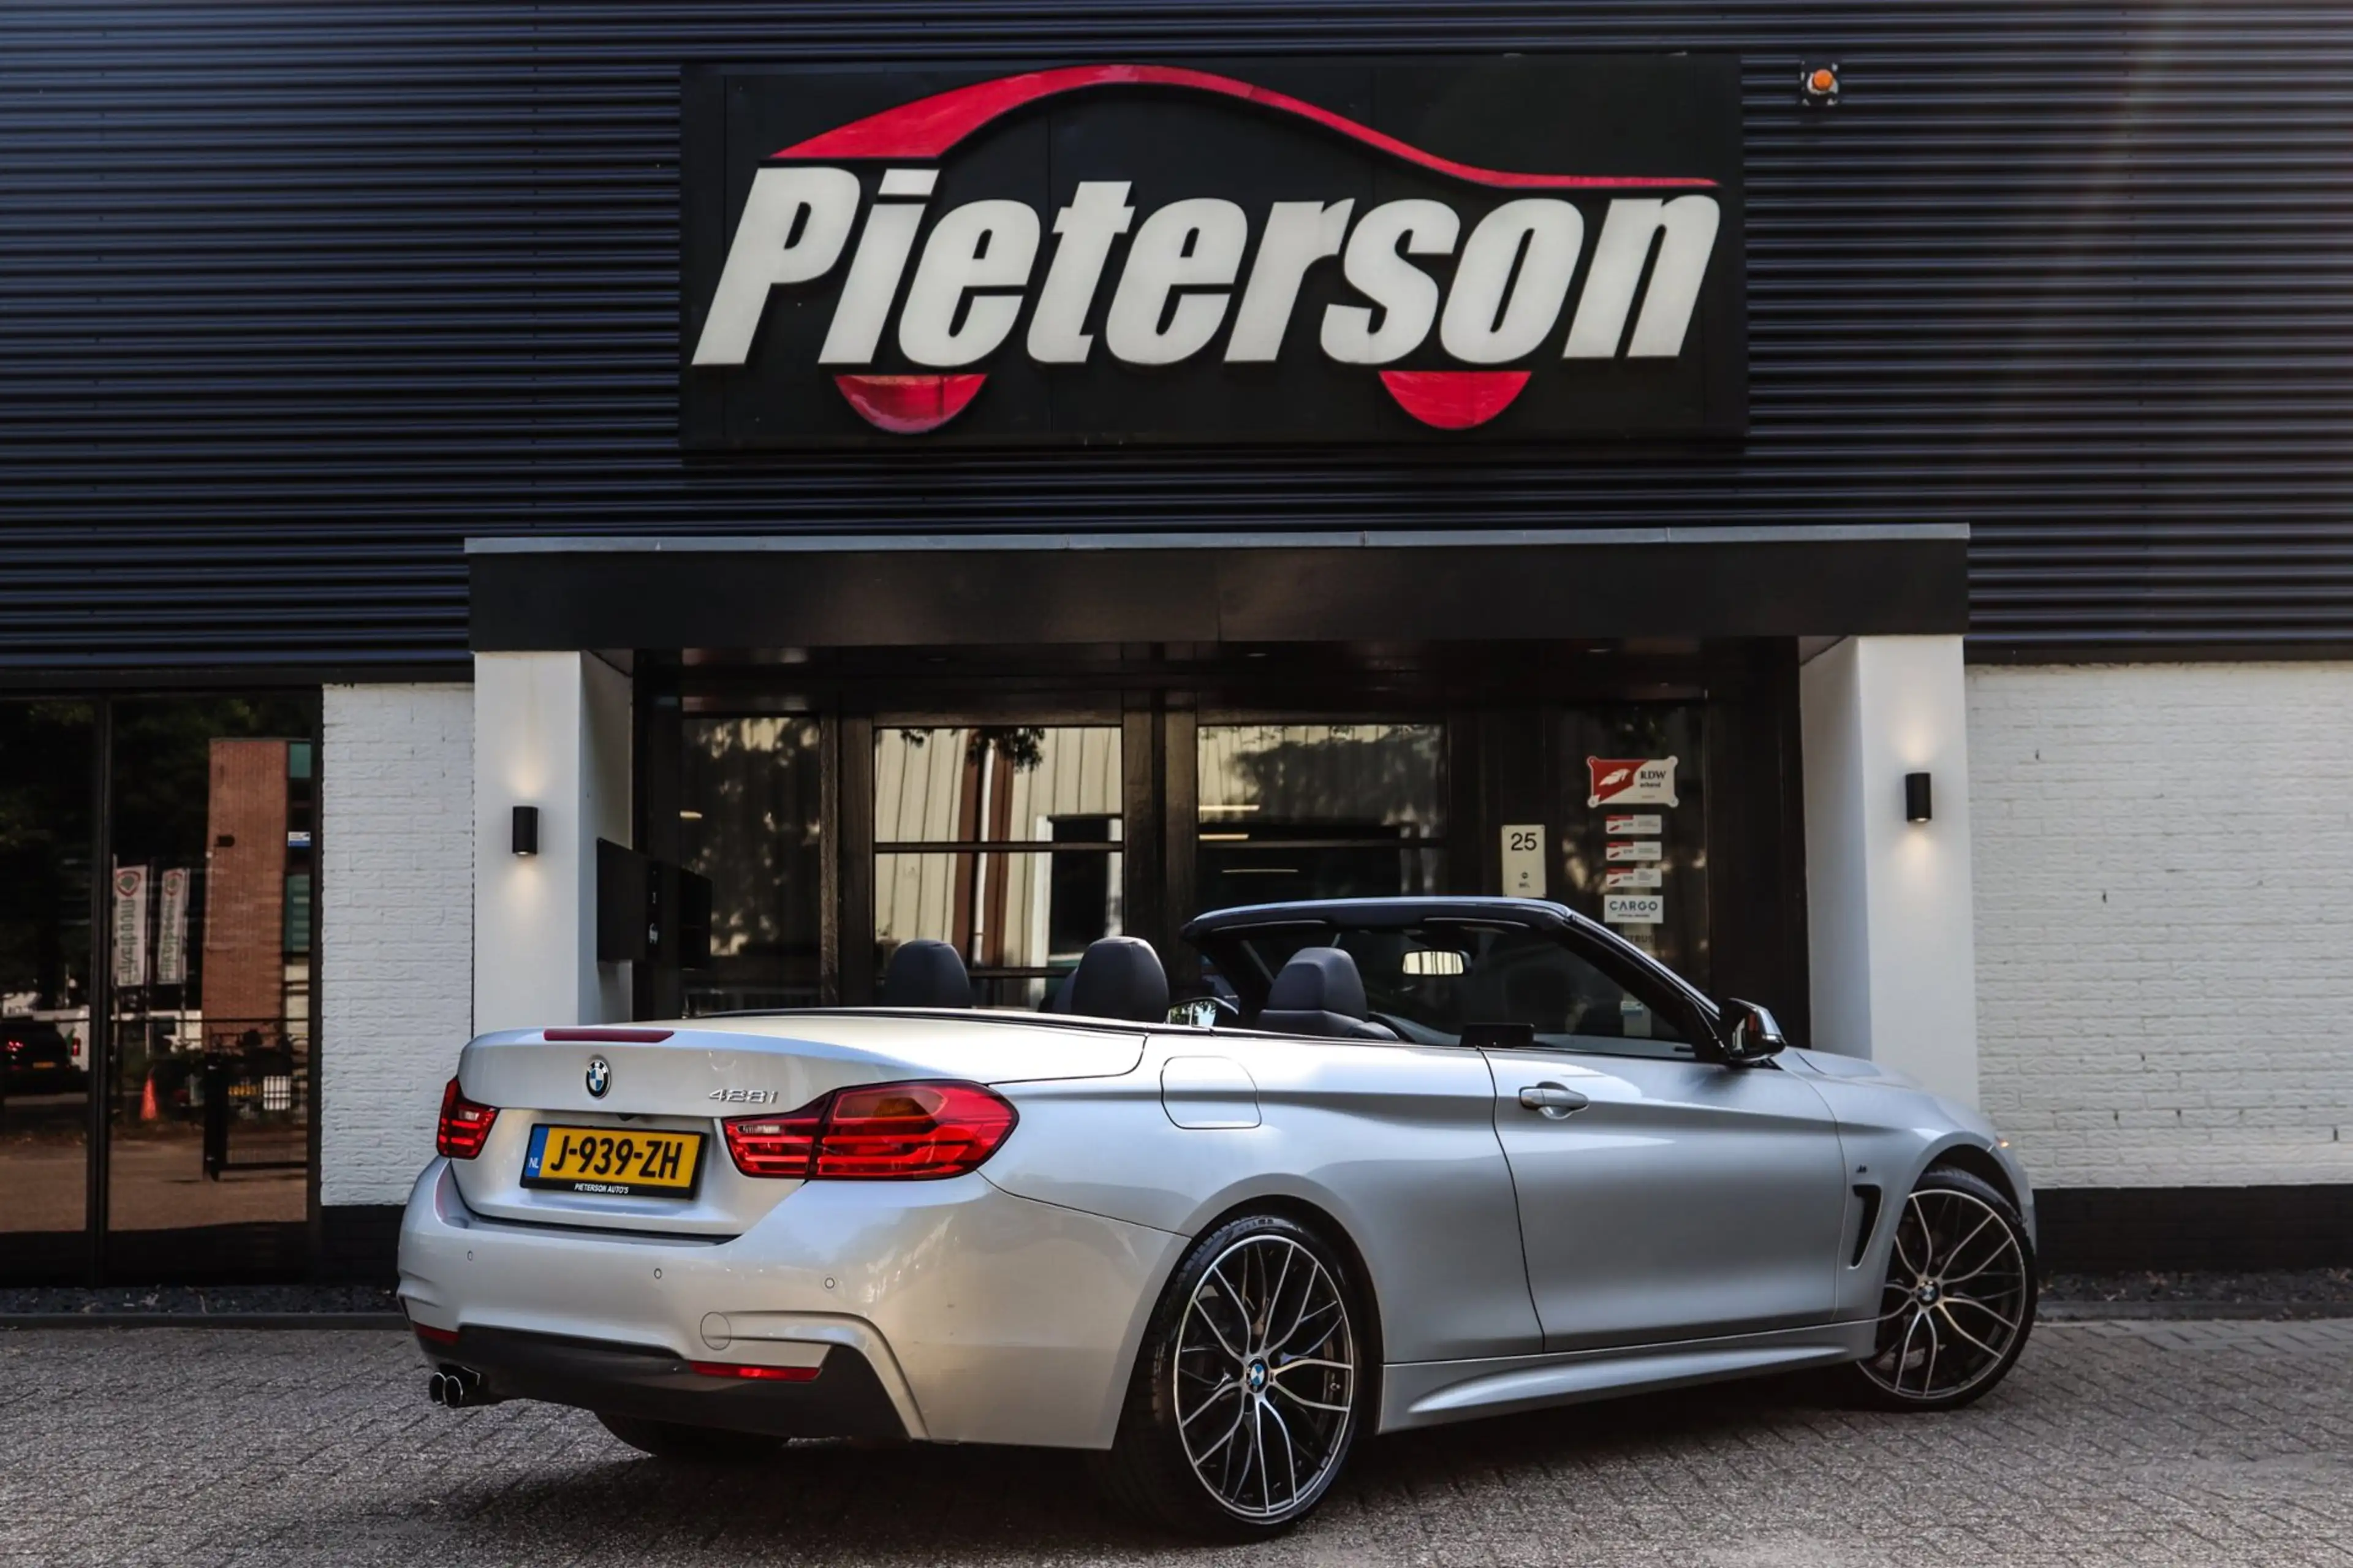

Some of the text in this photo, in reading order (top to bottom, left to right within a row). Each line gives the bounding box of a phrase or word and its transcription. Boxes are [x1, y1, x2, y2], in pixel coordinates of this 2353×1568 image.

[691, 166, 1720, 368] Pieterson
[1639, 770, 1666, 779] RDW
[1510, 832, 1537, 850] 25
[1609, 901, 1658, 911] CARGO
[528, 1157, 539, 1168] NL
[550, 1135, 683, 1179] J-939-ZH
[574, 1182, 629, 1194] PIETERSON AUTO'S
